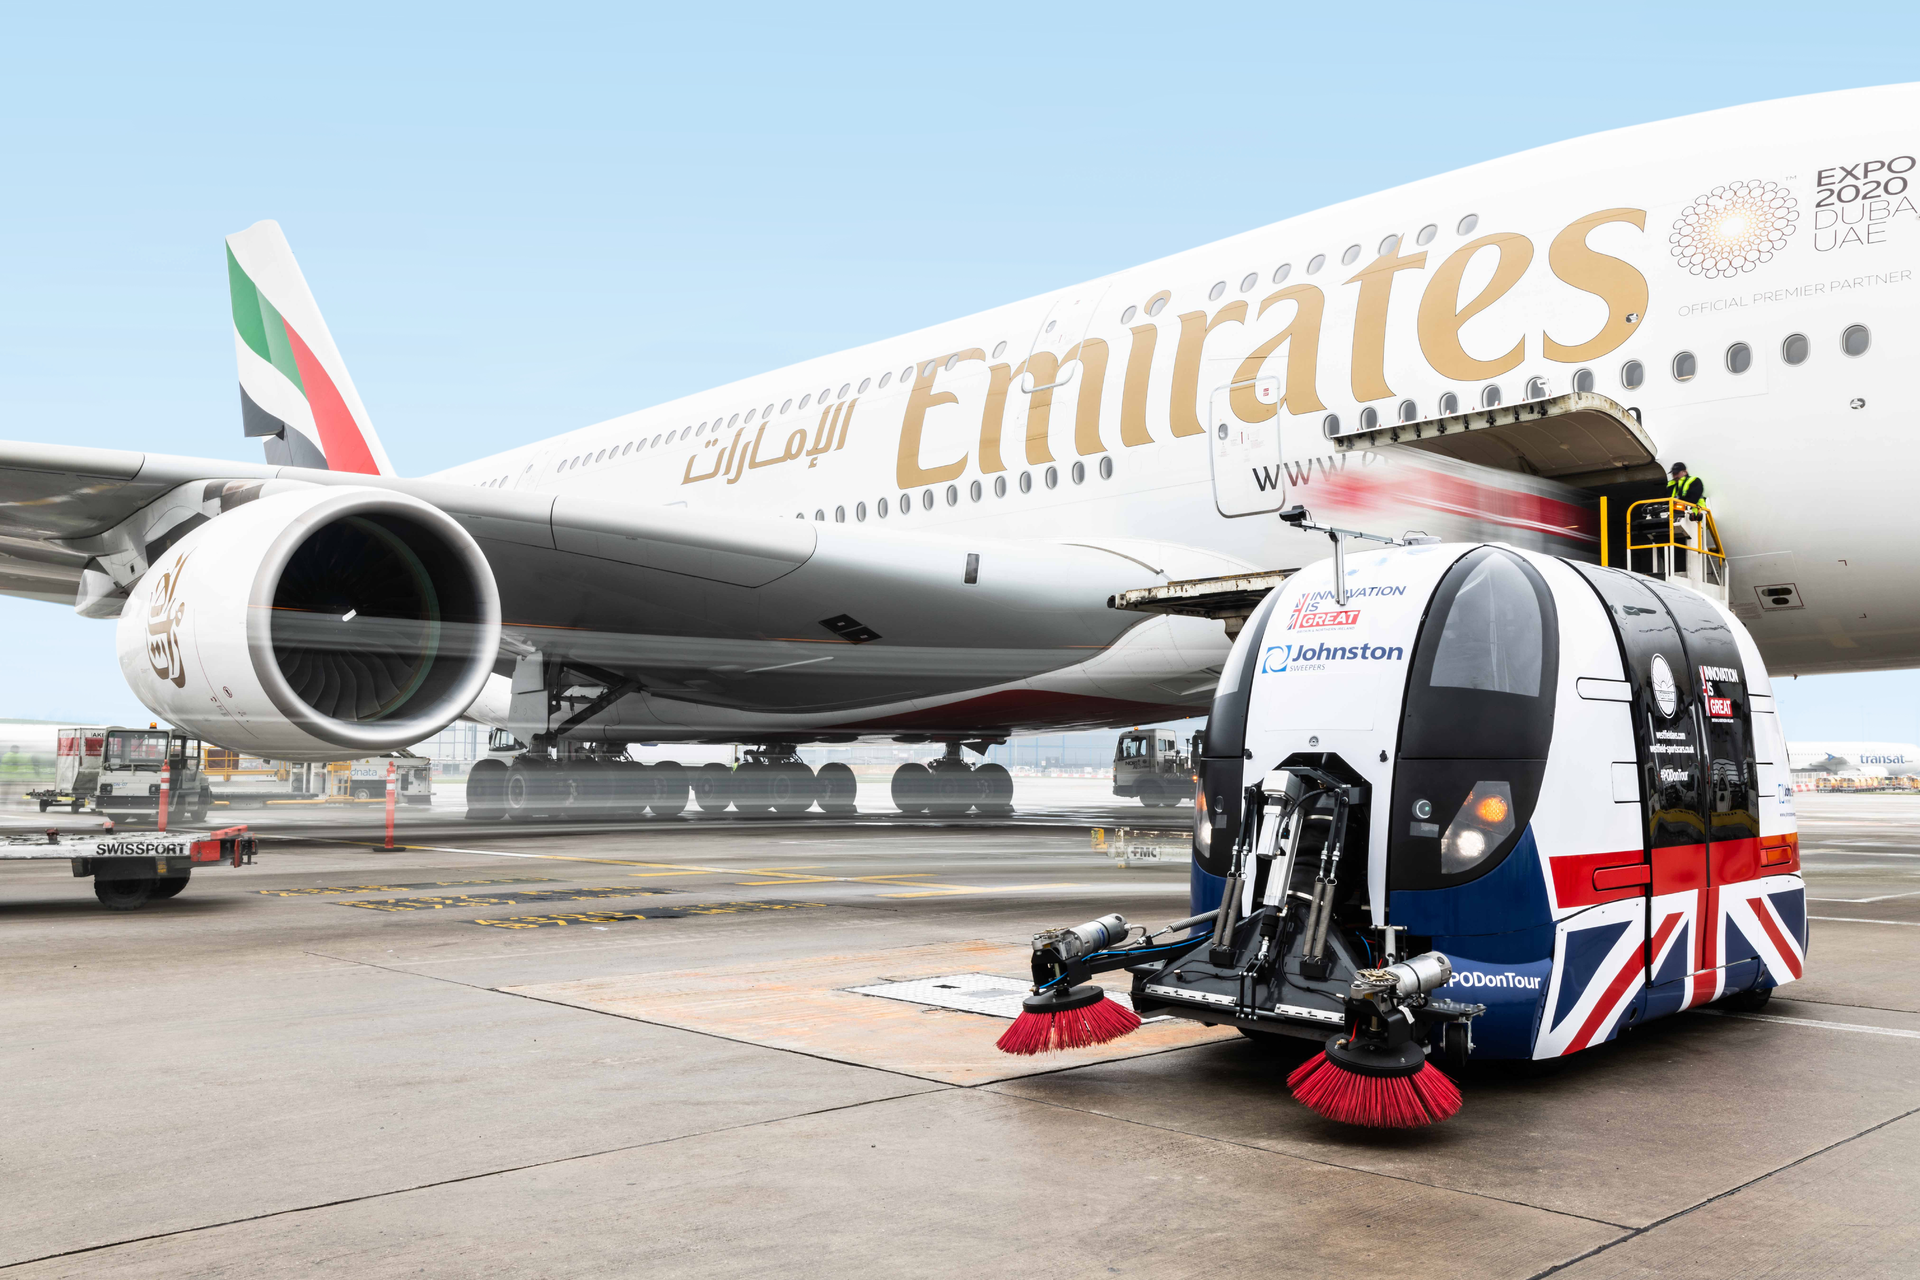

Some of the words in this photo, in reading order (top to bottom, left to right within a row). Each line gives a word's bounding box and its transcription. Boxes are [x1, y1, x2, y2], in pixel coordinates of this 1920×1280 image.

[1816, 155, 1917, 188] EXPO
[1815, 176, 1908, 208] 2020
[1814, 196, 1918, 230] DUBA
[1814, 221, 1888, 252] UAE
[1678, 296, 1749, 317] OFFICIAL
[1753, 283, 1826, 305] PREMIER
[1830, 269, 1912, 293] PARTNER
[896, 206, 1649, 490] Emirates
[1305, 602, 1320, 613] IS
[1302, 612, 1358, 627] GREAT
[1292, 643, 1404, 662] Johnston
[1289, 663, 1326, 672] SWEEPERS
[1703, 665, 1739, 683] INNOVATION
[1706, 681, 1715, 697] IS
[1710, 699, 1732, 715] GREAT
[1860, 754, 1905, 764] transat
[350, 768, 378, 777] dnata
[1660, 769, 1689, 781] #PODonTour
[96, 843, 186, 857] SWISSPORT
[1443, 971, 1541, 990] PODonTour
